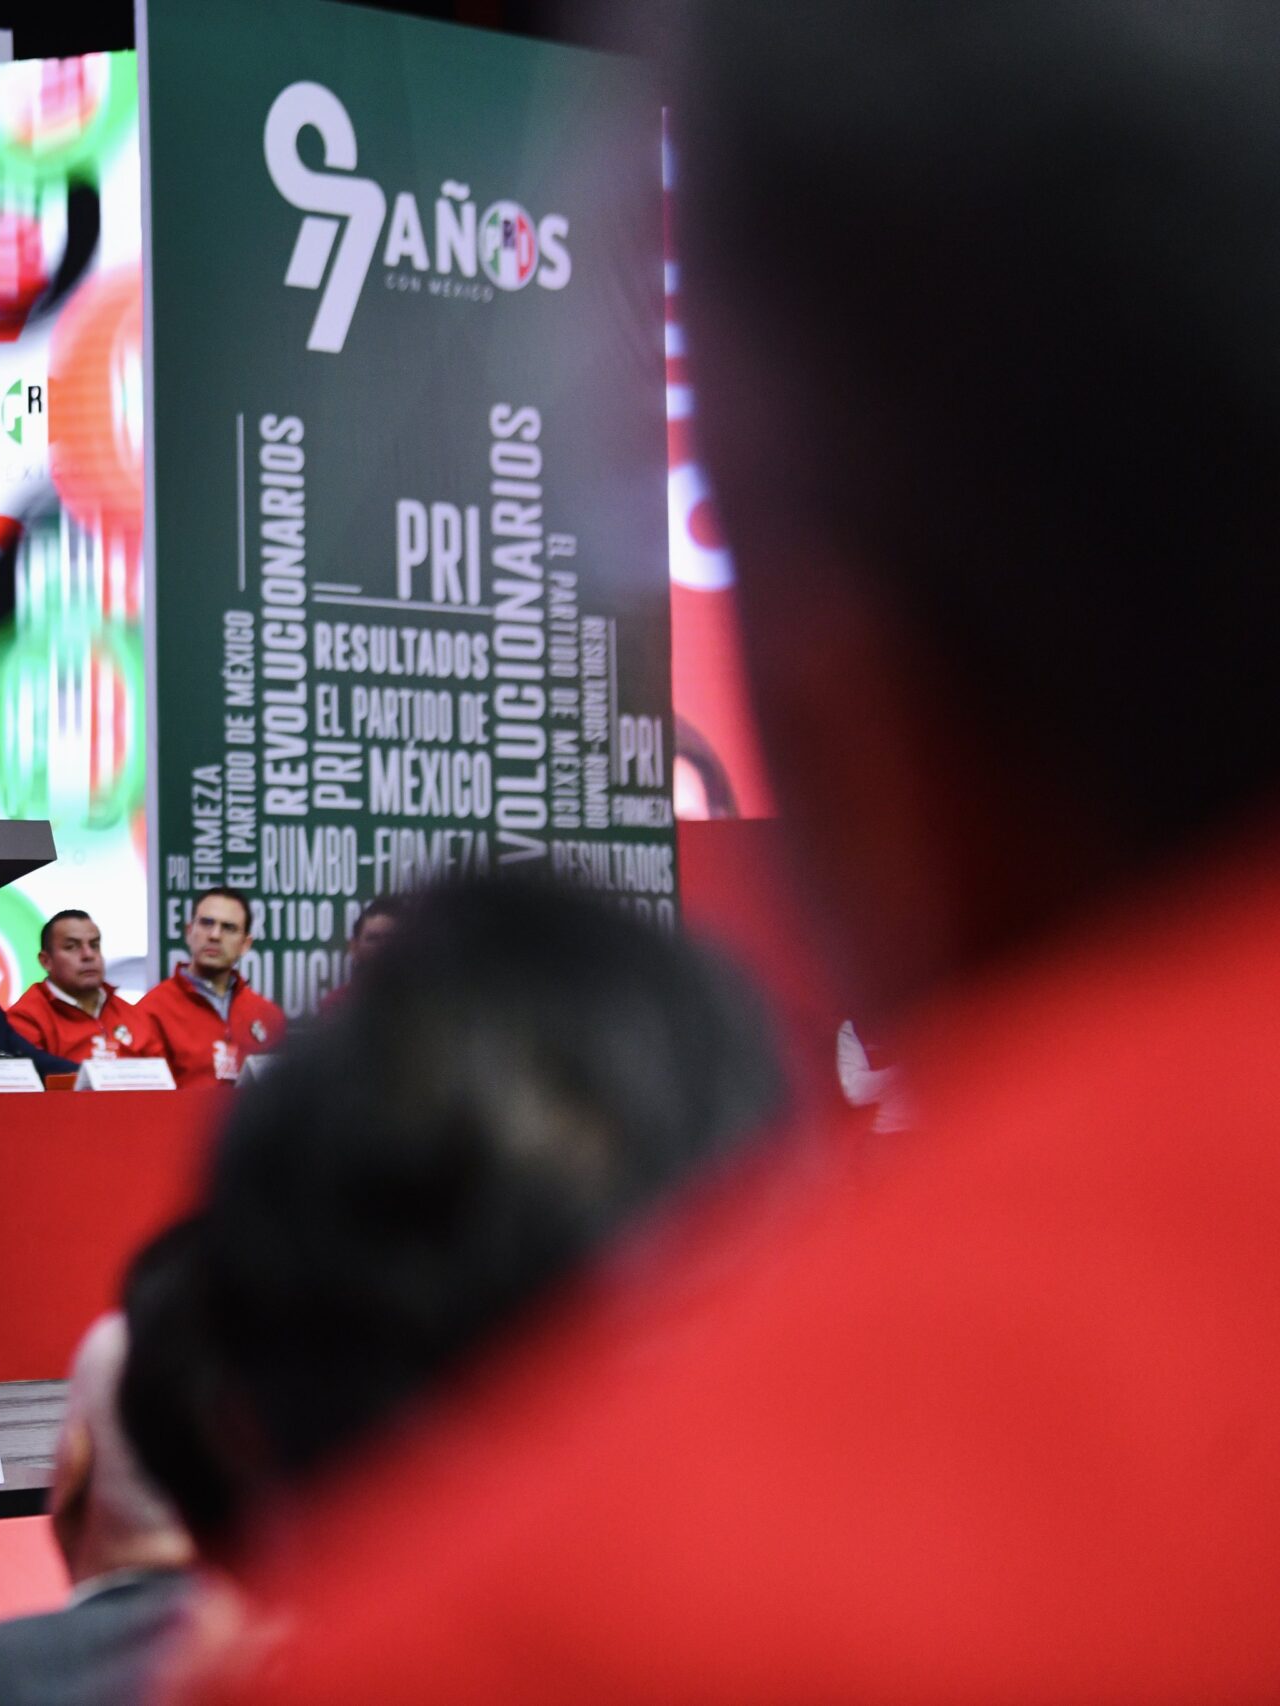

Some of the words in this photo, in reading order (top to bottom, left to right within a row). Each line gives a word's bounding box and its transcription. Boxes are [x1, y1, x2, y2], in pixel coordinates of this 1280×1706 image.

[383, 179, 573, 291] AÑOS
[396, 498, 481, 607] PRI
[260, 413, 308, 816] REVOLUCIONARIOS
[313, 620, 490, 681] RESULTADOS
[219, 608, 256, 708] MÉXICO
[223, 712, 256, 745] DE
[315, 684, 346, 738] EL
[351, 685, 454, 744] PARTIDO
[457, 691, 490, 745] DE
[620, 714, 665, 788] PRI
[224, 750, 257, 854] PARTIDO
[312, 740, 364, 811] PRI
[368, 736, 493, 820] MÉXICO
[191, 763, 223, 890] FIRMEZA
[225, 860, 258, 889] EL
